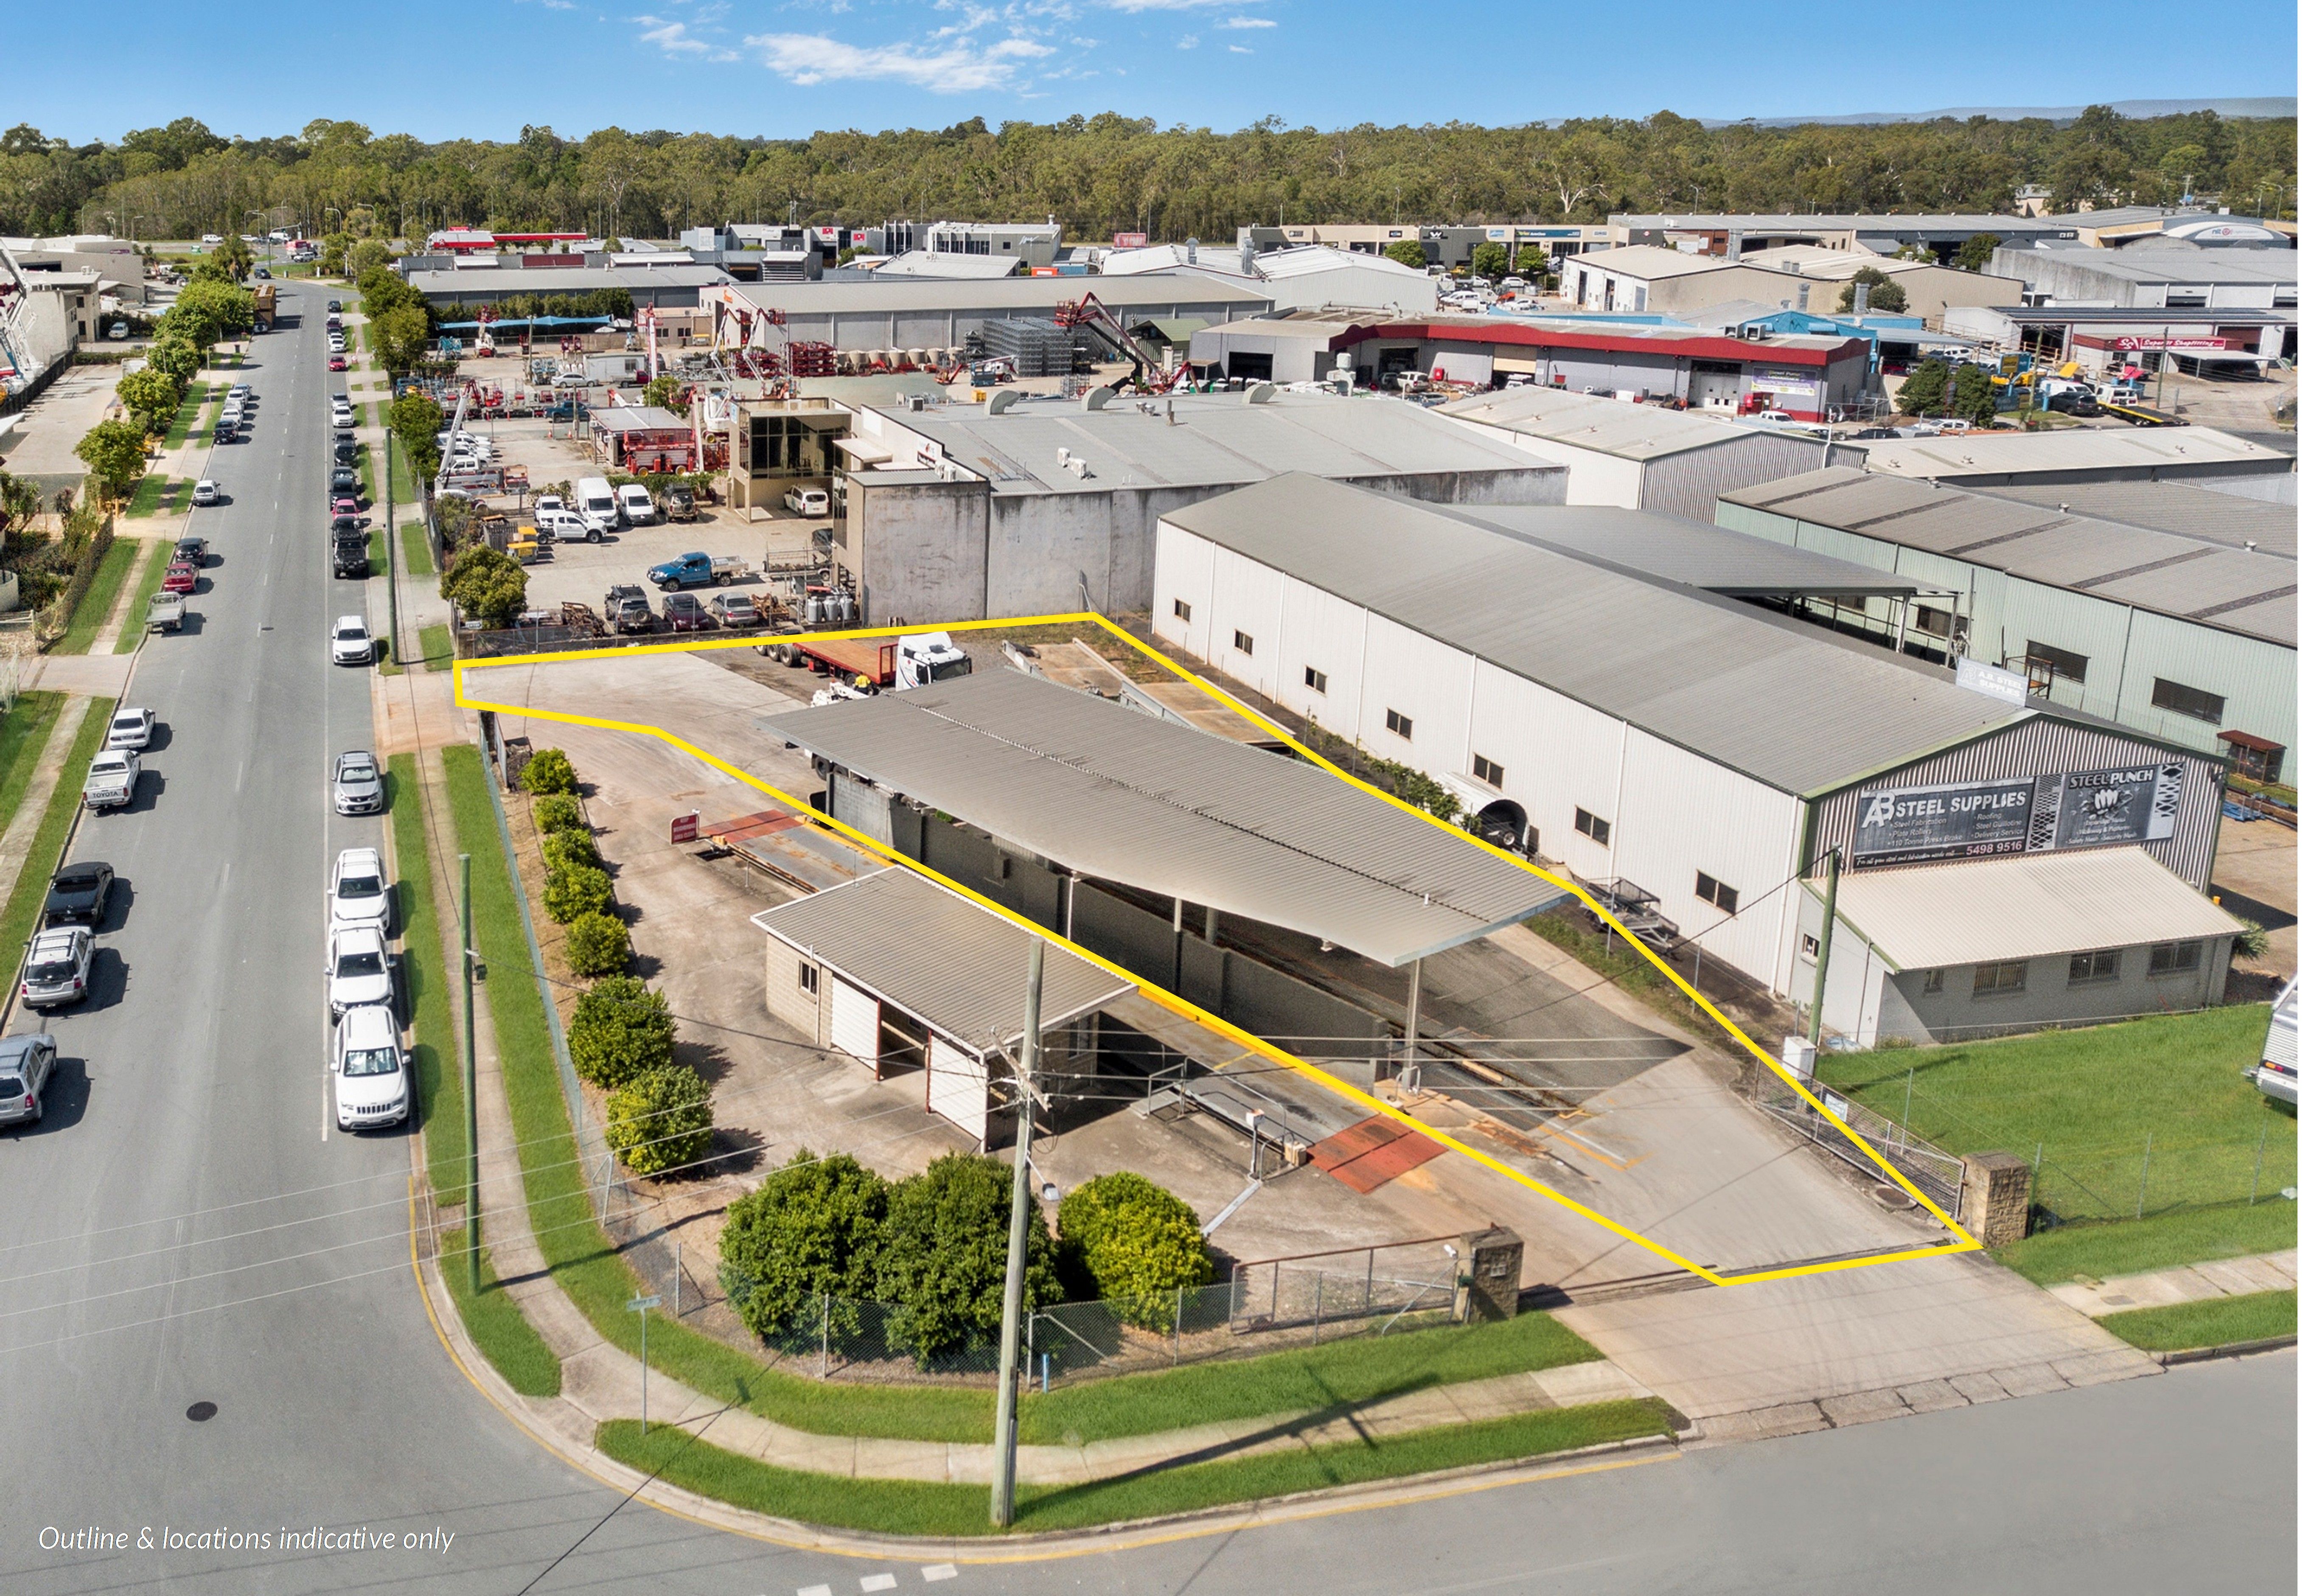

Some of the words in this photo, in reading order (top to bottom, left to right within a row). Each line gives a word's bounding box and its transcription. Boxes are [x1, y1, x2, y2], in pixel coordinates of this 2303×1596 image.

[1979, 679, 2020, 697] SUPPLIES
[1997, 676, 2022, 687] STEEL
[2069, 774, 2109, 788] STEEL
[2110, 769, 2154, 784] PUNCH
[1896, 799, 1946, 818] STEEL
[1950, 791, 2027, 813] SUPPLIES
[1911, 818, 1947, 827] Fabrication
[1977, 812, 2002, 820] Roofing
[1904, 838, 1924, 846] Tonne
[1944, 834, 1963, 842] Brake
[1966, 842, 1994, 856] 5498
[1997, 840, 2022, 853] 9516
